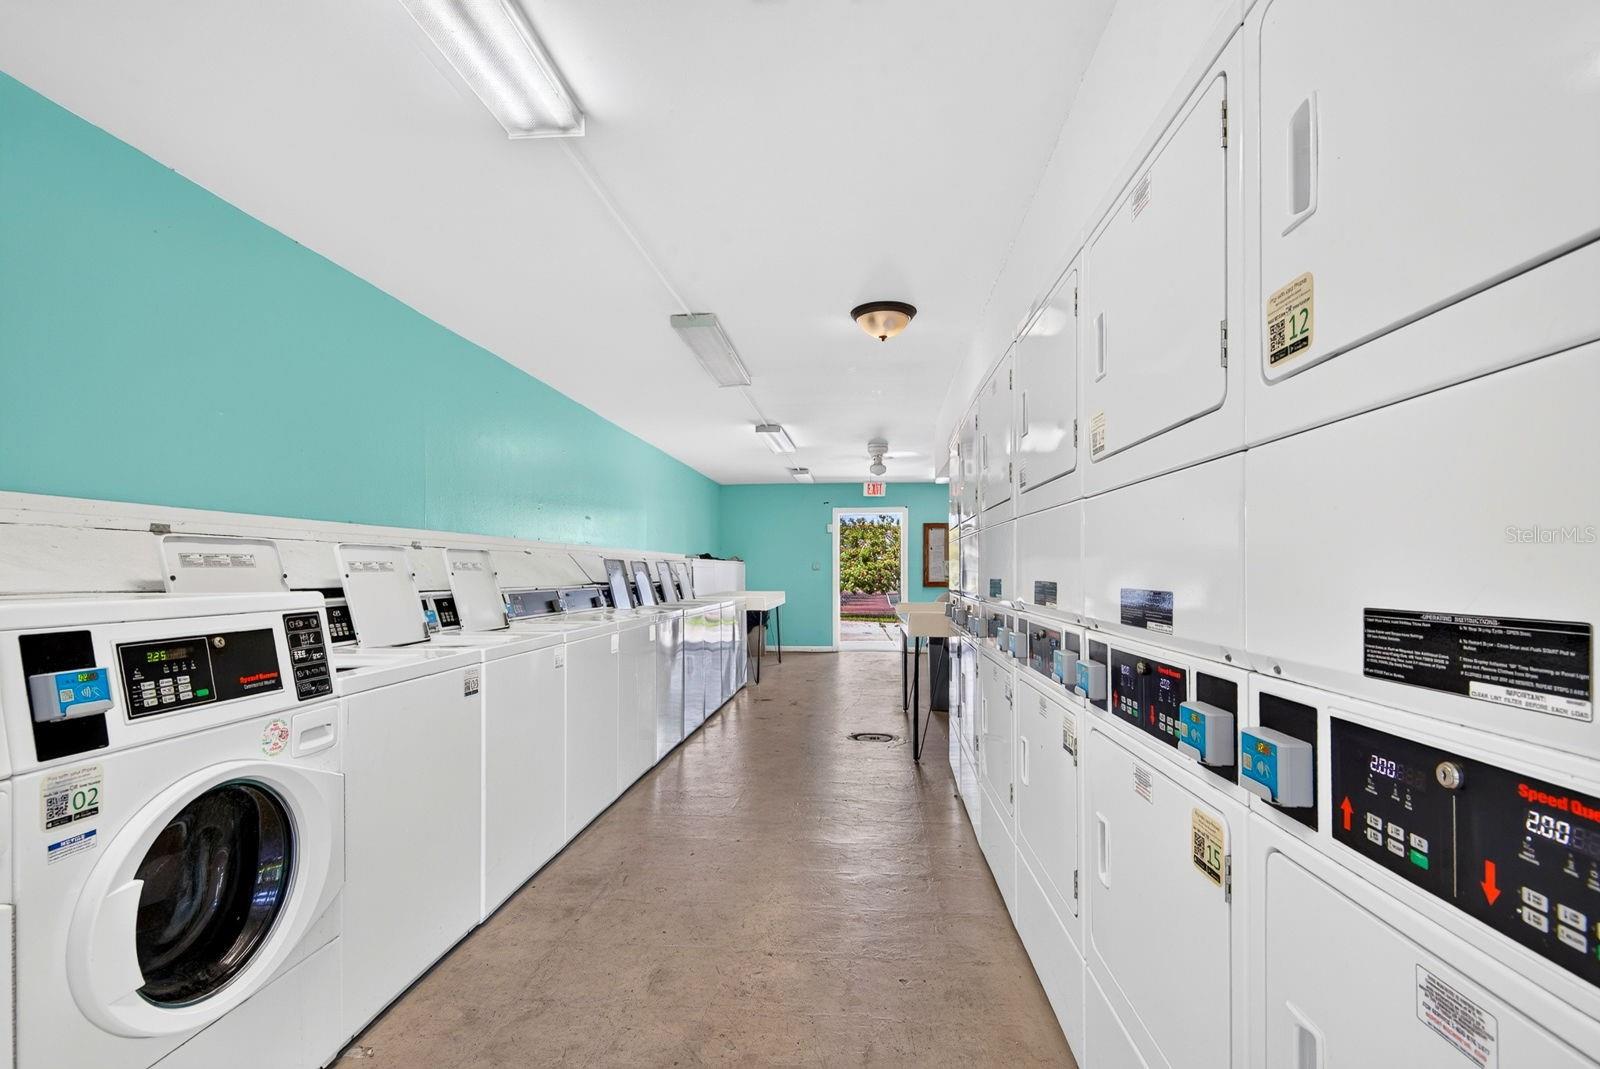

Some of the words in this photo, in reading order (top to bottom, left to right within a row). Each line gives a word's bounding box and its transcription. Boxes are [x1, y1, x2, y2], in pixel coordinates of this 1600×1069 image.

[1289, 307, 1309, 340] 12
[866, 482, 882, 495] EXIT
[73, 788, 99, 810] 02
[1518, 784, 1569, 812] Speed
[1206, 844, 1220, 871] 15
